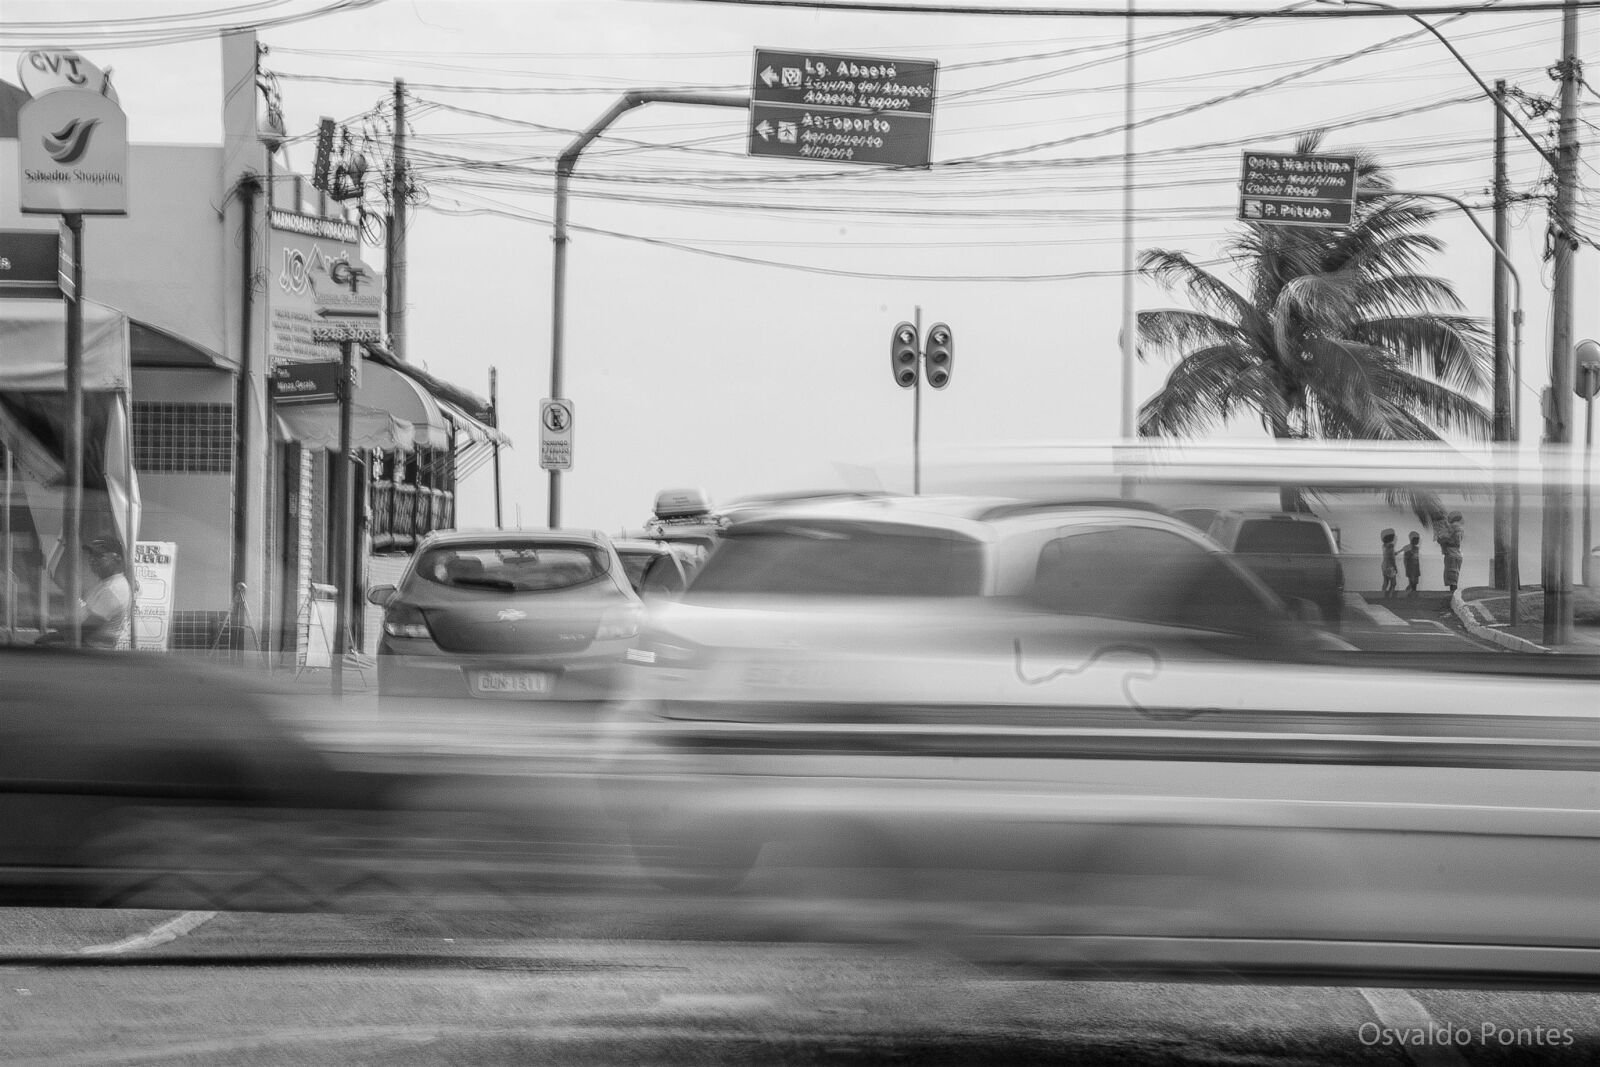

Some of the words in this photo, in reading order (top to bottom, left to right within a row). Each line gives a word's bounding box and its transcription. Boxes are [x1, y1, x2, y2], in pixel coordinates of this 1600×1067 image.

[801, 113, 891, 133] Aeroporto
[800, 130, 884, 148] Aeropuerto
[799, 144, 855, 159] Airport
[24, 168, 71, 185] Salvador
[73, 168, 123, 186] Shopping
[1280, 204, 1332, 219] Pituba
